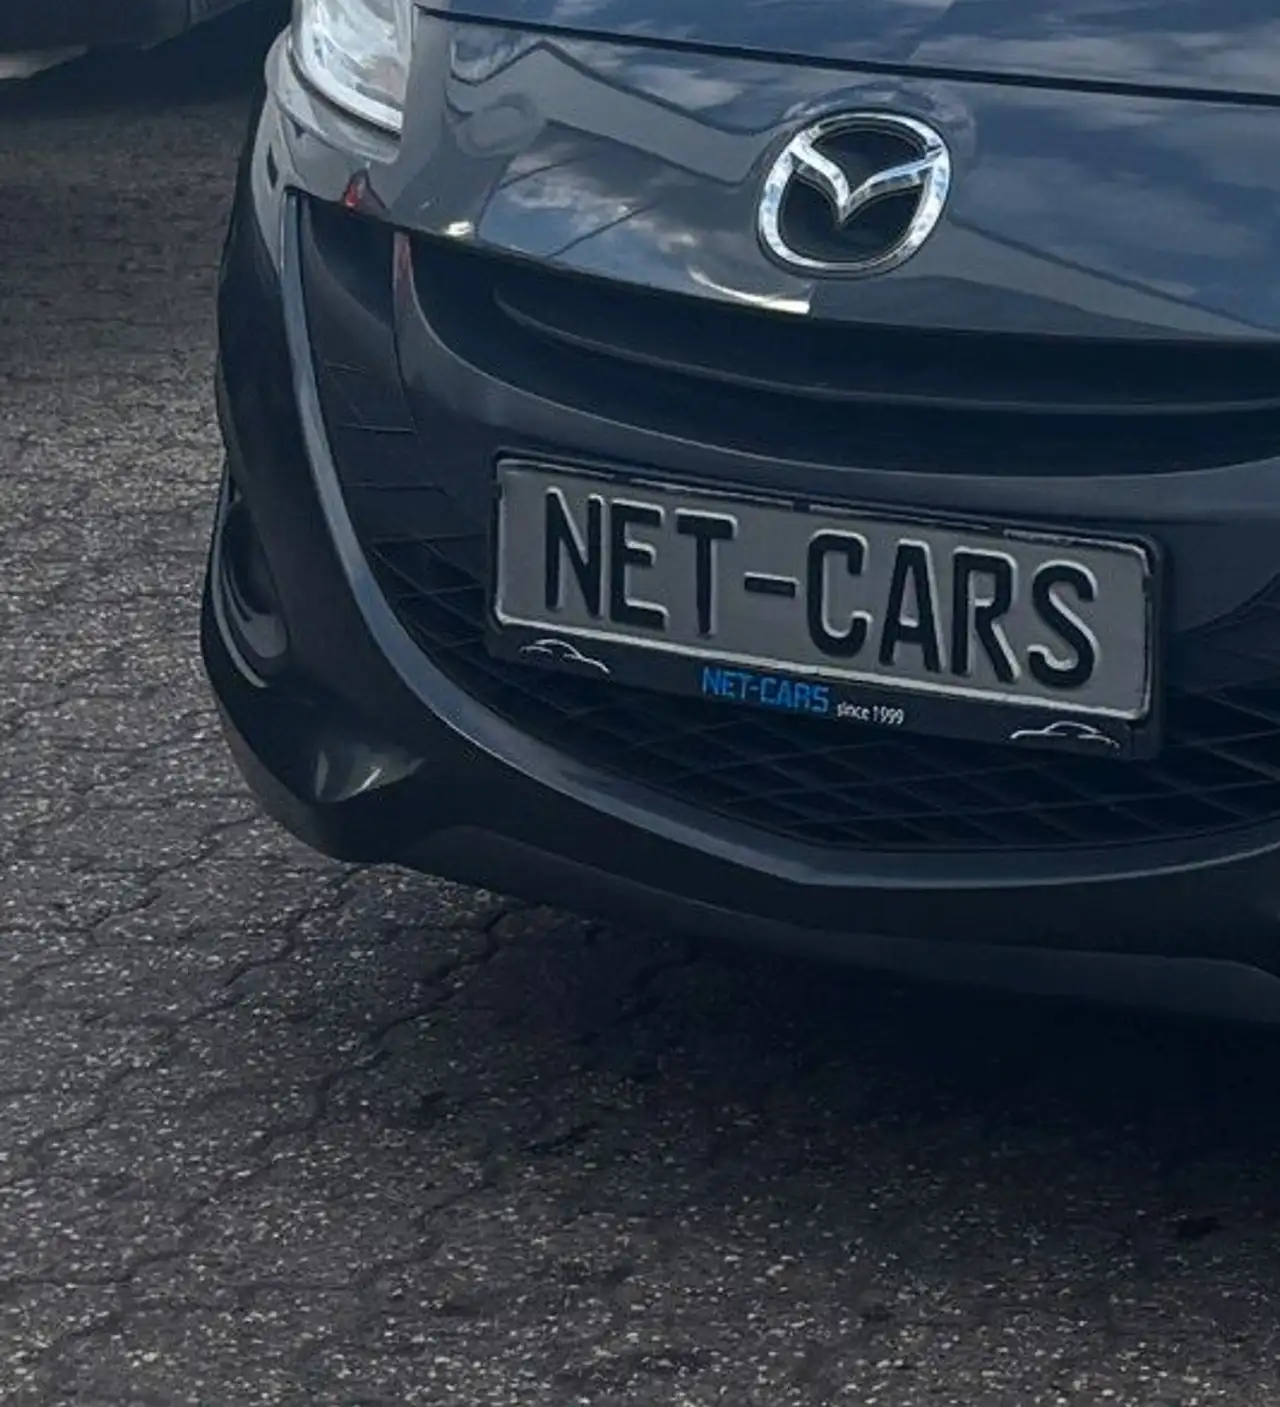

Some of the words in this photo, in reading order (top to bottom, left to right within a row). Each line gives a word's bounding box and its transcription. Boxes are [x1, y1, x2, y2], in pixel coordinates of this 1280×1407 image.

[543, 485, 1099, 689] NET-CARS
[702, 665, 830, 714] NET-CARS
[836, 699, 870, 722] since
[872, 704, 905, 726] 1999
